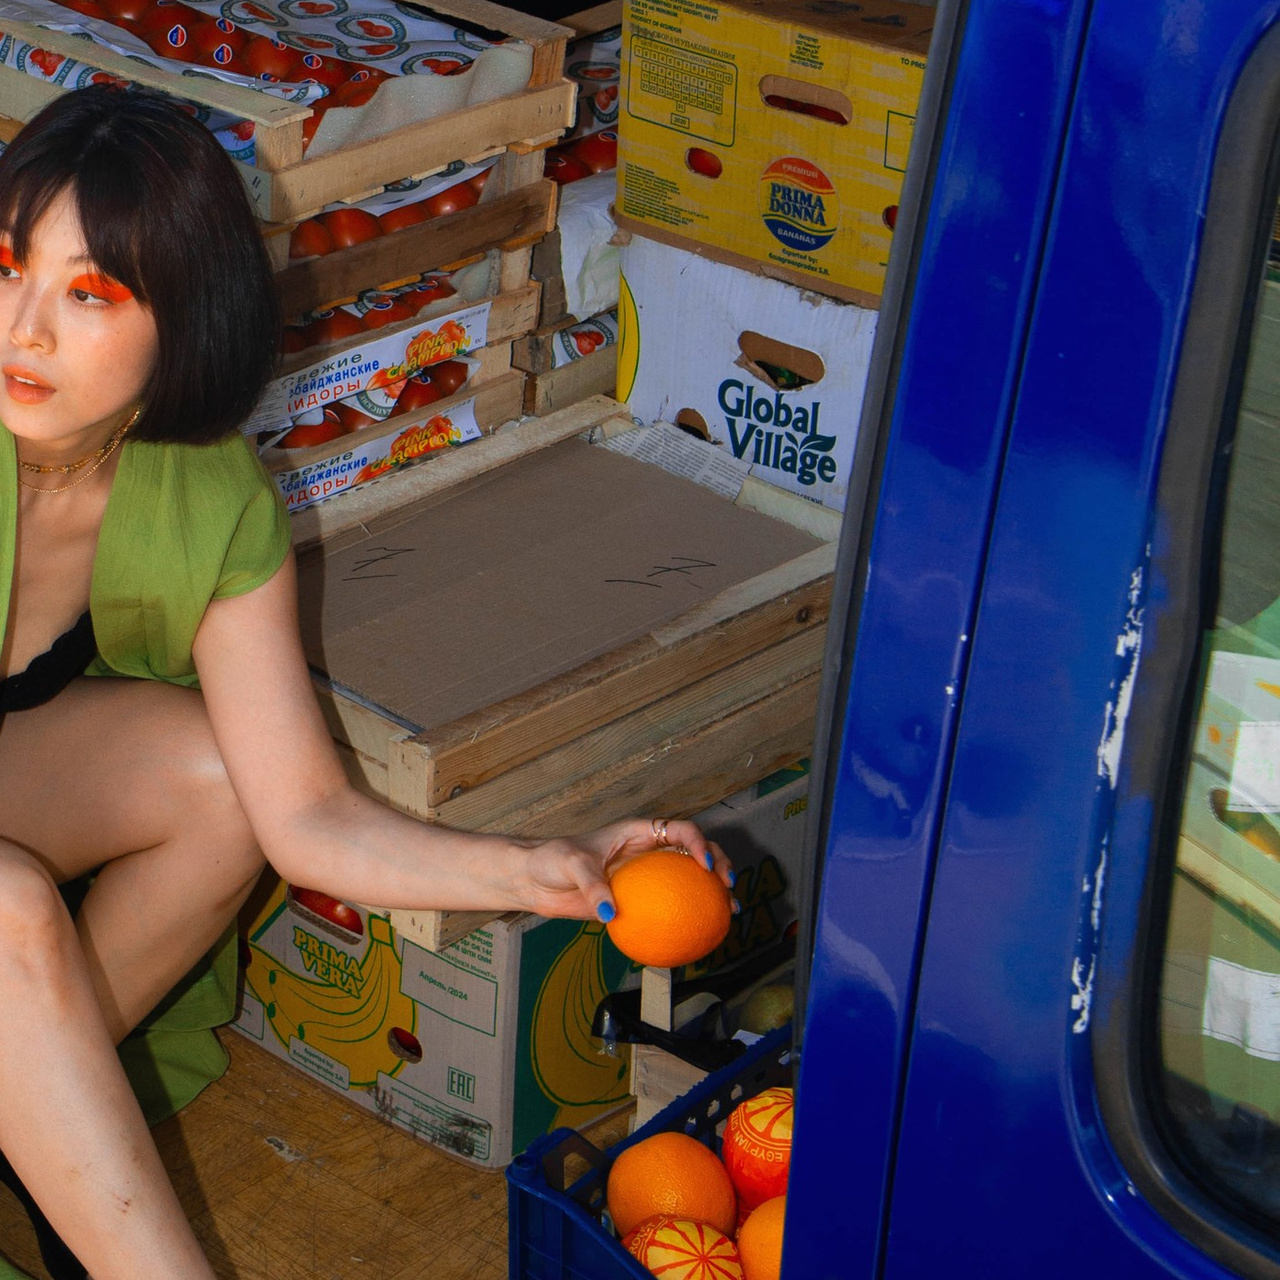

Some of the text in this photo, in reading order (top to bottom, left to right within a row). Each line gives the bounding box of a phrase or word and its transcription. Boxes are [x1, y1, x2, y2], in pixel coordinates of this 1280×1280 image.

[782, 163, 819, 179] PREMIUM
[769, 197, 826, 227] DONNA
[771, 182, 826, 212] PRIMA
[777, 227, 816, 245] BANANAS
[408, 336, 447, 357] PINK
[718, 378, 821, 436] Global
[370, 426, 462, 471] CHAMPION
[394, 426, 433, 450] PINK
[724, 416, 837, 486] Village
[293, 925, 363, 981] PRIMA
[300, 949, 361, 999] VERA
[450, 1071, 472, 1100] EAC
[732, 1131, 784, 1162] EGYPTIAN
